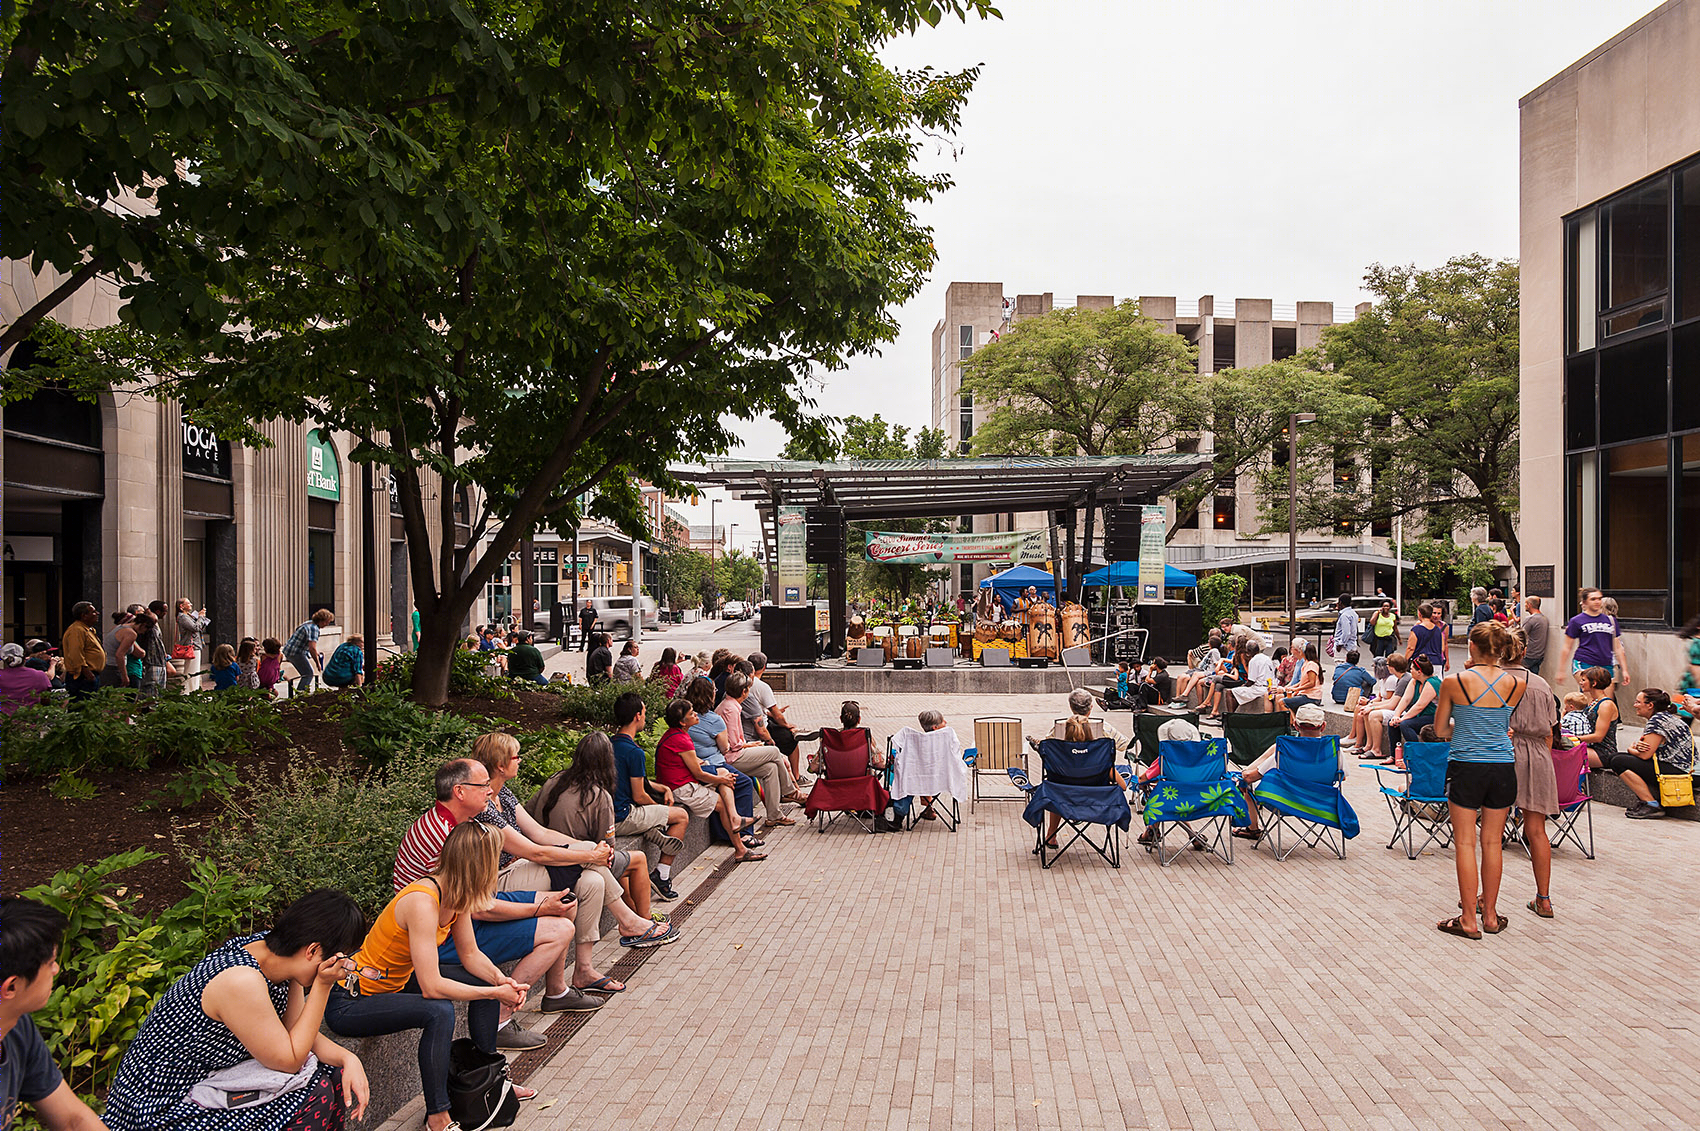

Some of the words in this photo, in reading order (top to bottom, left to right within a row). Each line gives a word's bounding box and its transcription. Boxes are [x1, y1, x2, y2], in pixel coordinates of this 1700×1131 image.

[181, 422, 218, 451] IOGA
[187, 446, 218, 461] LACE
[315, 472, 337, 492] Bank
[897, 534, 931, 543] Summer
[1023, 533, 1041, 542] Free
[870, 543, 911, 556] Concert
[912, 540, 944, 552] Series
[1023, 542, 1041, 551] Live
[507, 551, 556, 560] COFEE
[1020, 550, 1045, 559] Music
